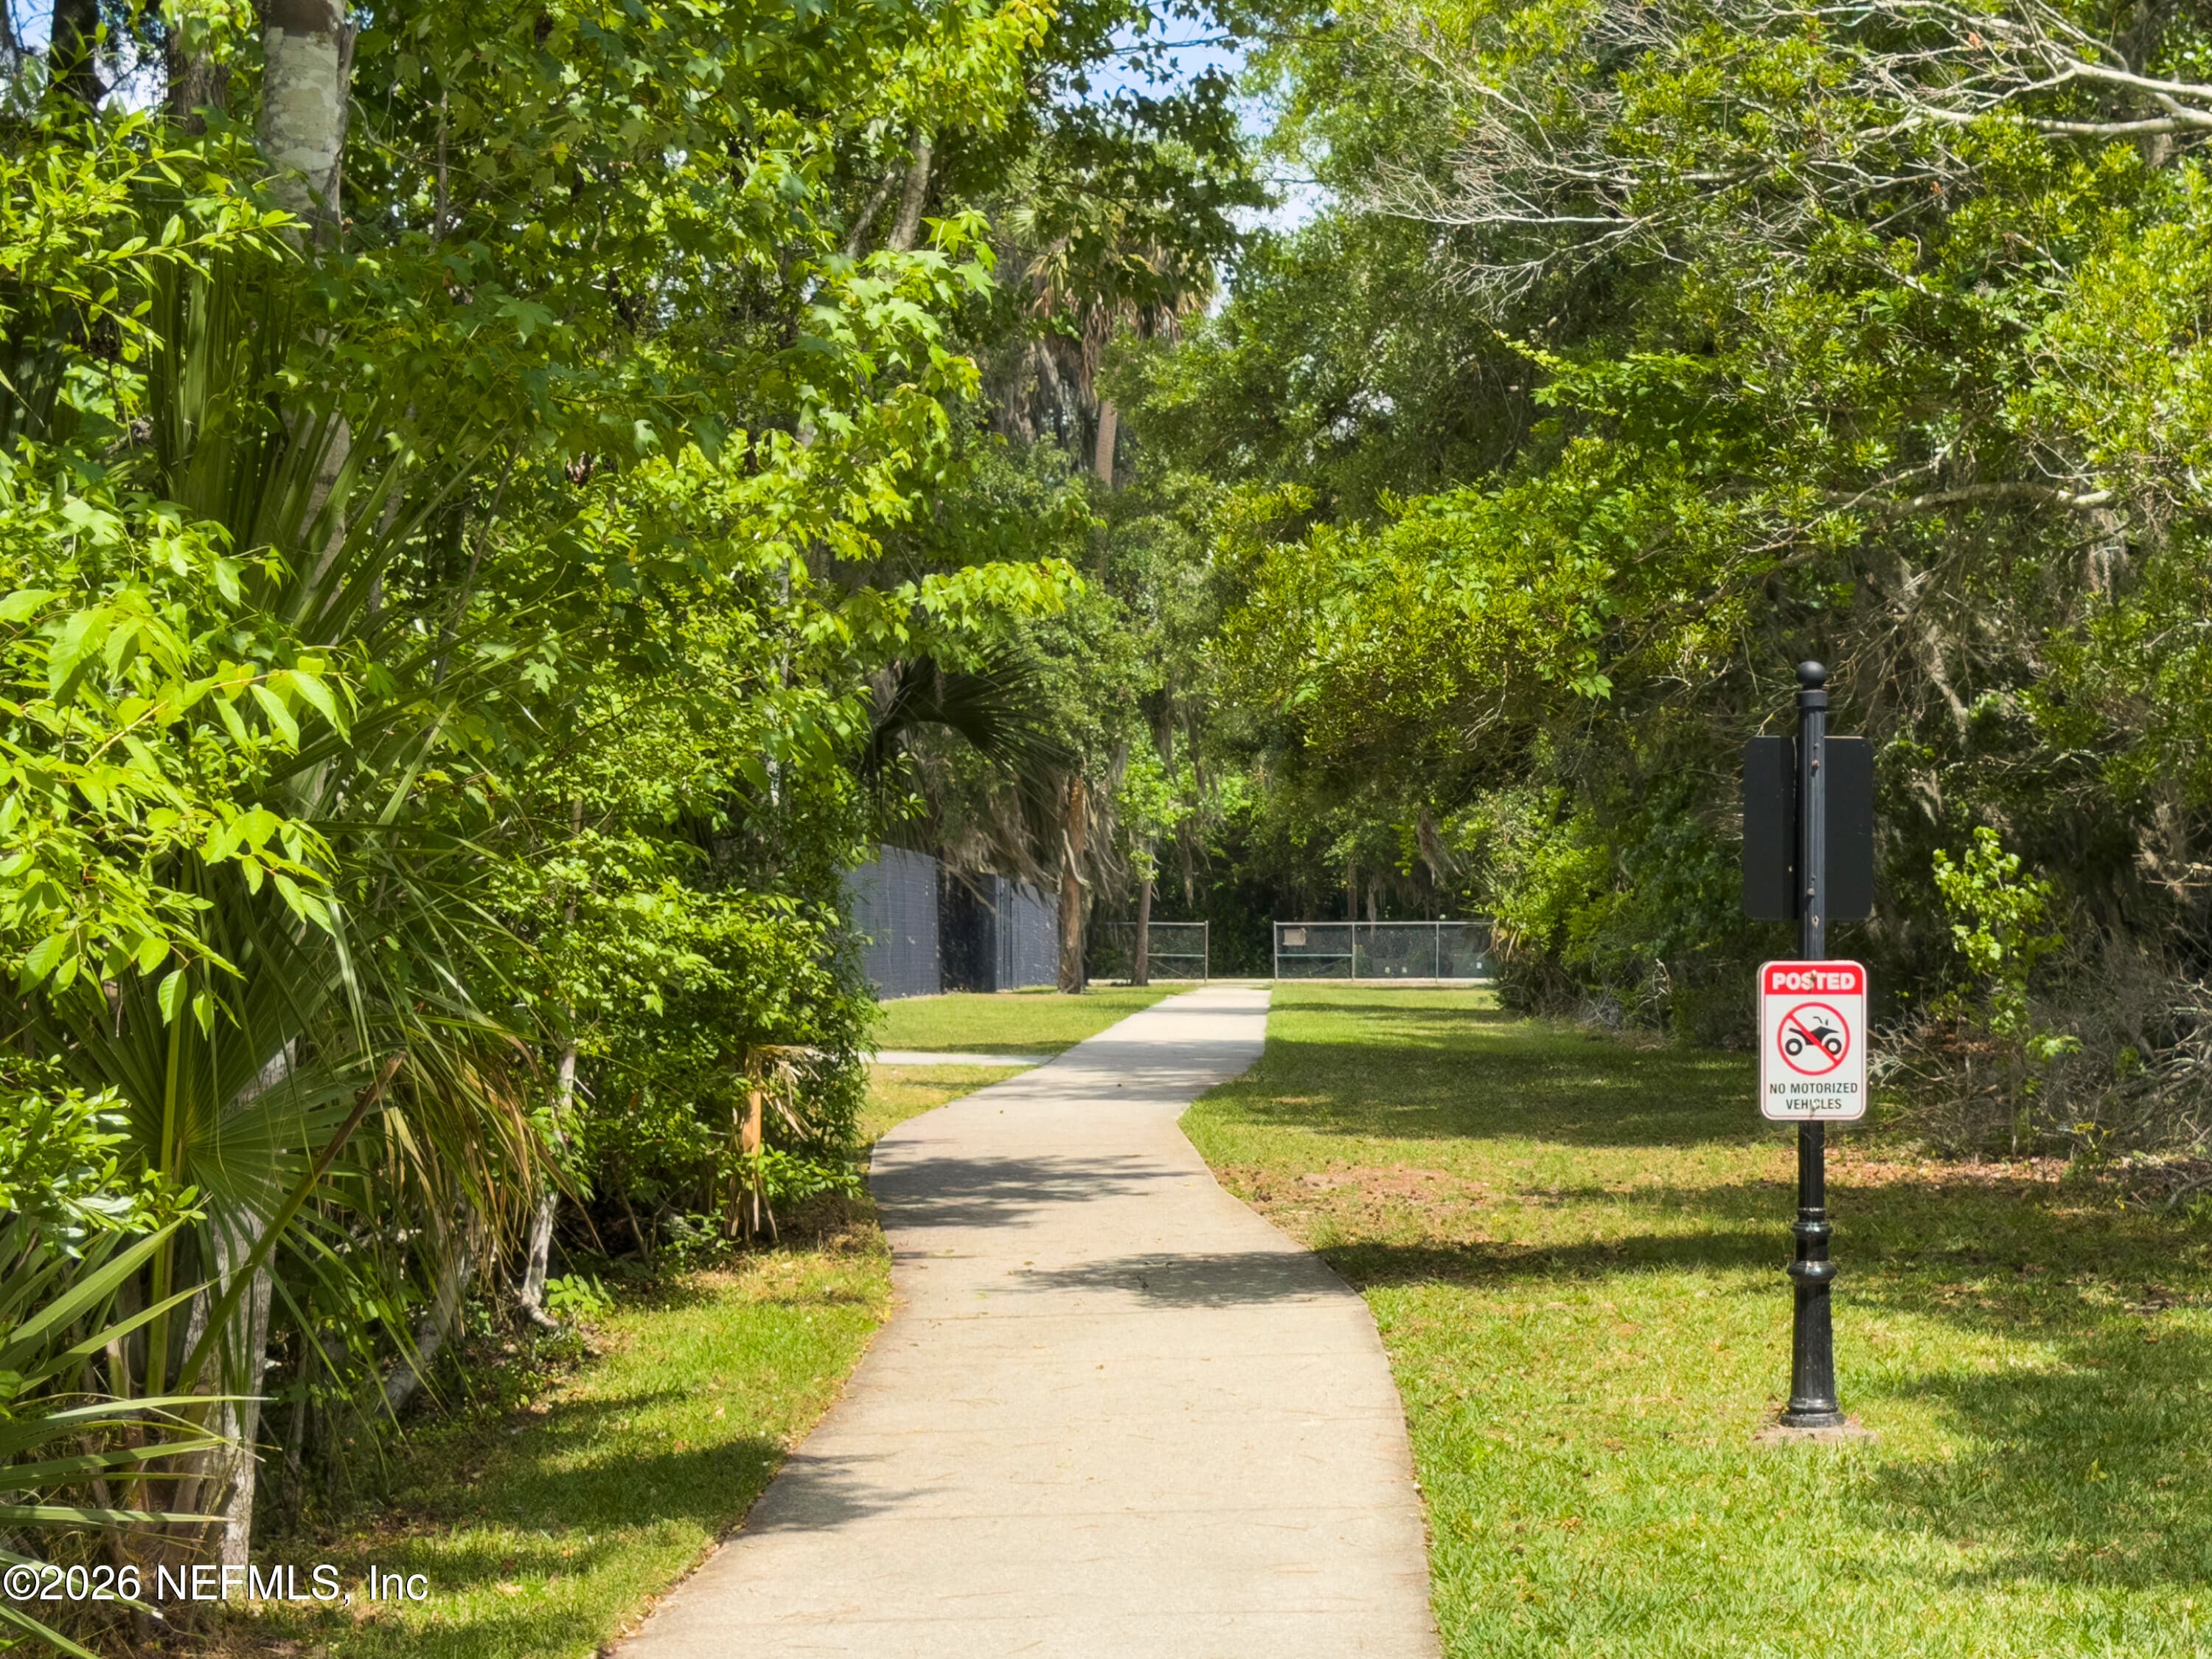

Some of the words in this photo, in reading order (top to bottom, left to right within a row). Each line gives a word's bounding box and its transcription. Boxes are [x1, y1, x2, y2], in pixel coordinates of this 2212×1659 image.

[1773, 973, 1856, 990] POSTED
[1770, 1083, 1786, 1094] NO
[1791, 1082, 1857, 1094] MOTORIZED
[1786, 1099, 1842, 1110] VEHICLES
